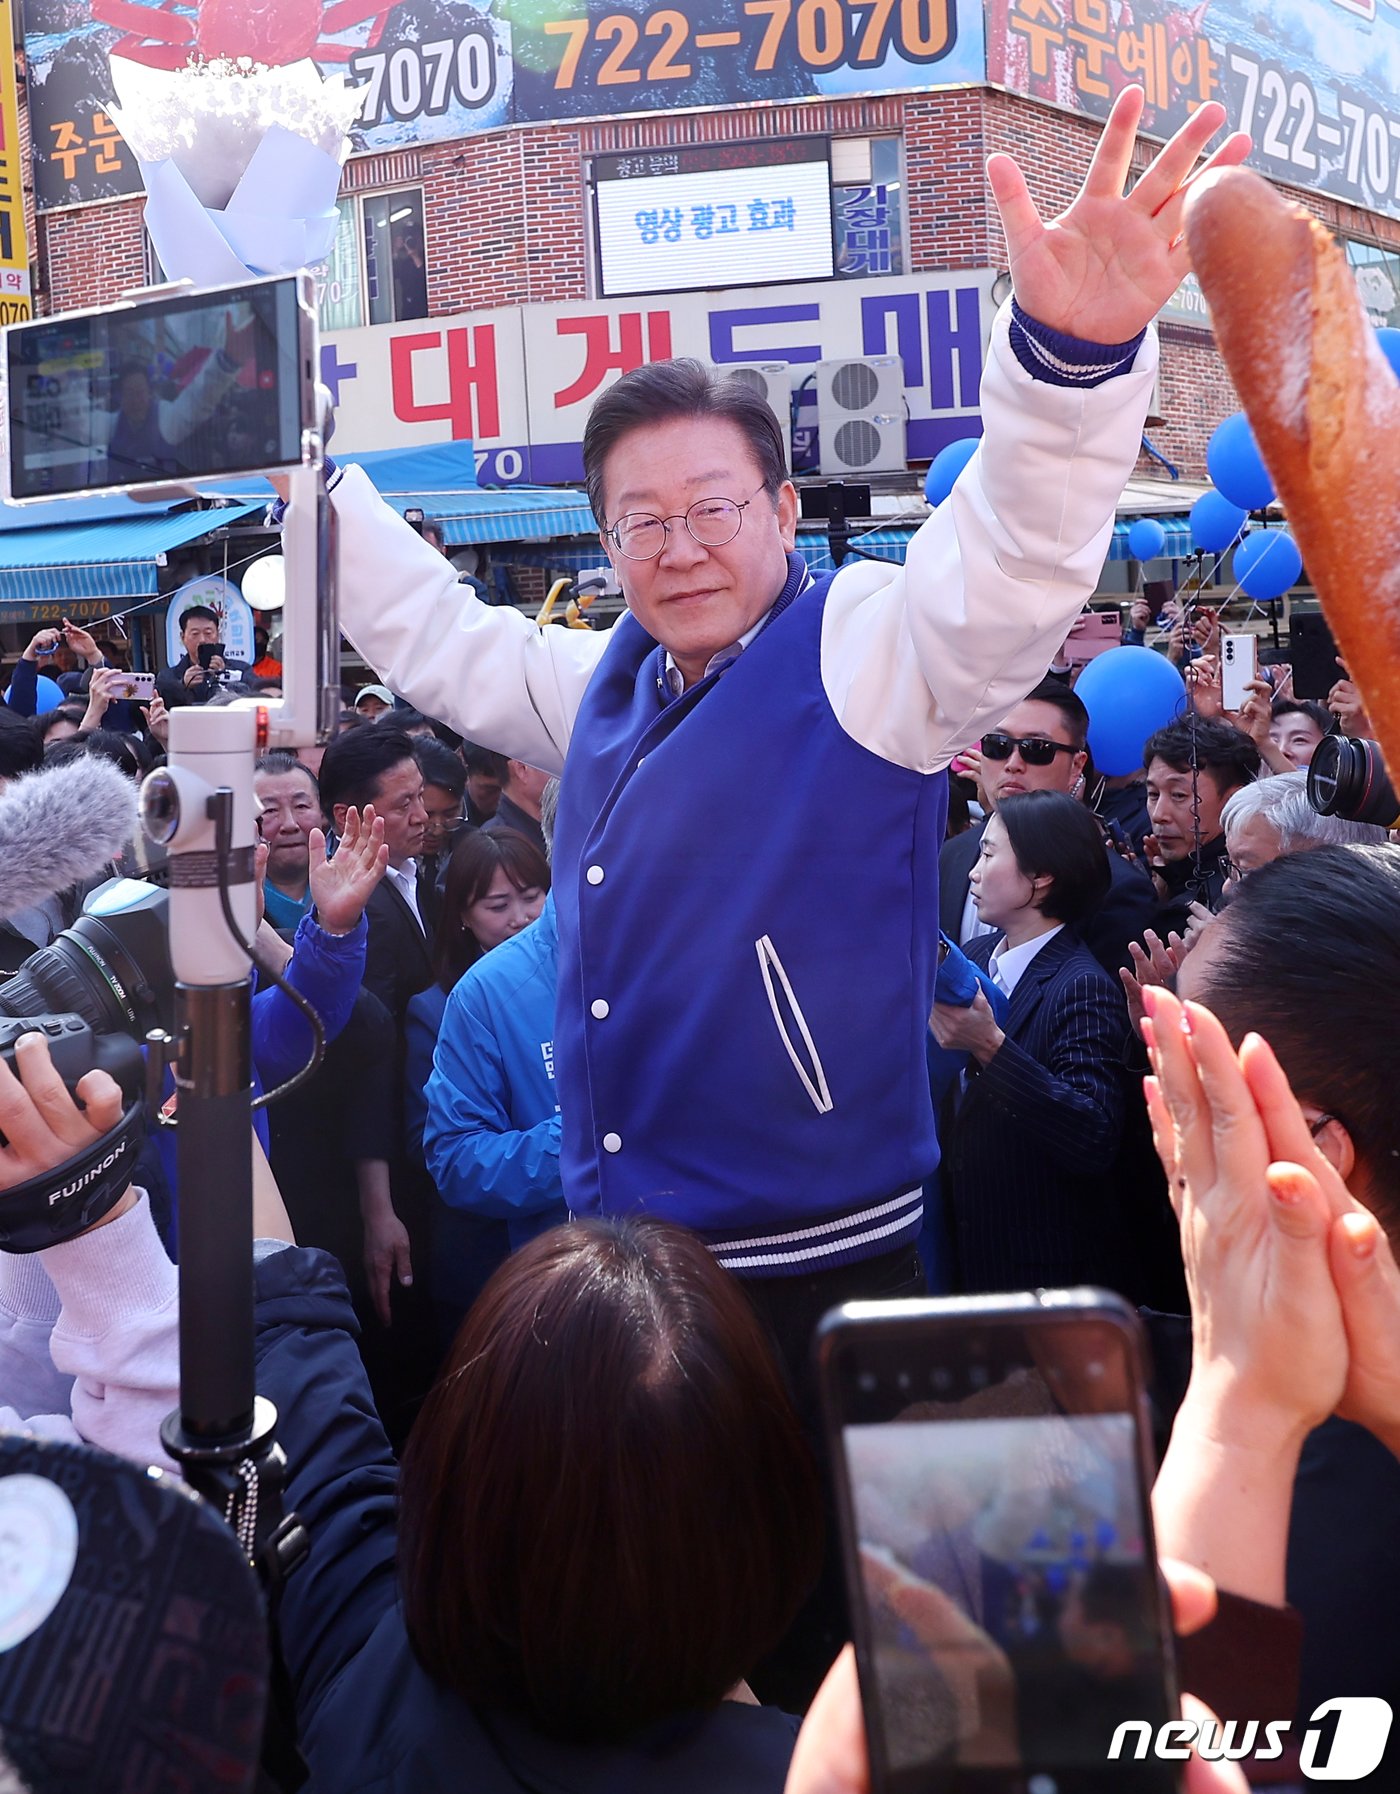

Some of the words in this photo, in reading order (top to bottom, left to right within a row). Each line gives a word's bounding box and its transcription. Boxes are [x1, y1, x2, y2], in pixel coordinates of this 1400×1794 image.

[355, 33, 491, 122] 7070
[544, 0, 949, 90] 722-7070
[1010, 0, 1219, 113] 주문예약
[635, 206, 684, 245] 영상
[691, 203, 740, 240] 광고
[747, 196, 797, 232] 효과
[837, 184, 892, 274] 기장대게
[0, 272, 22, 291] 약
[31, 601, 110, 620] 722-7070
[48, 1141, 126, 1206] FUJINON
